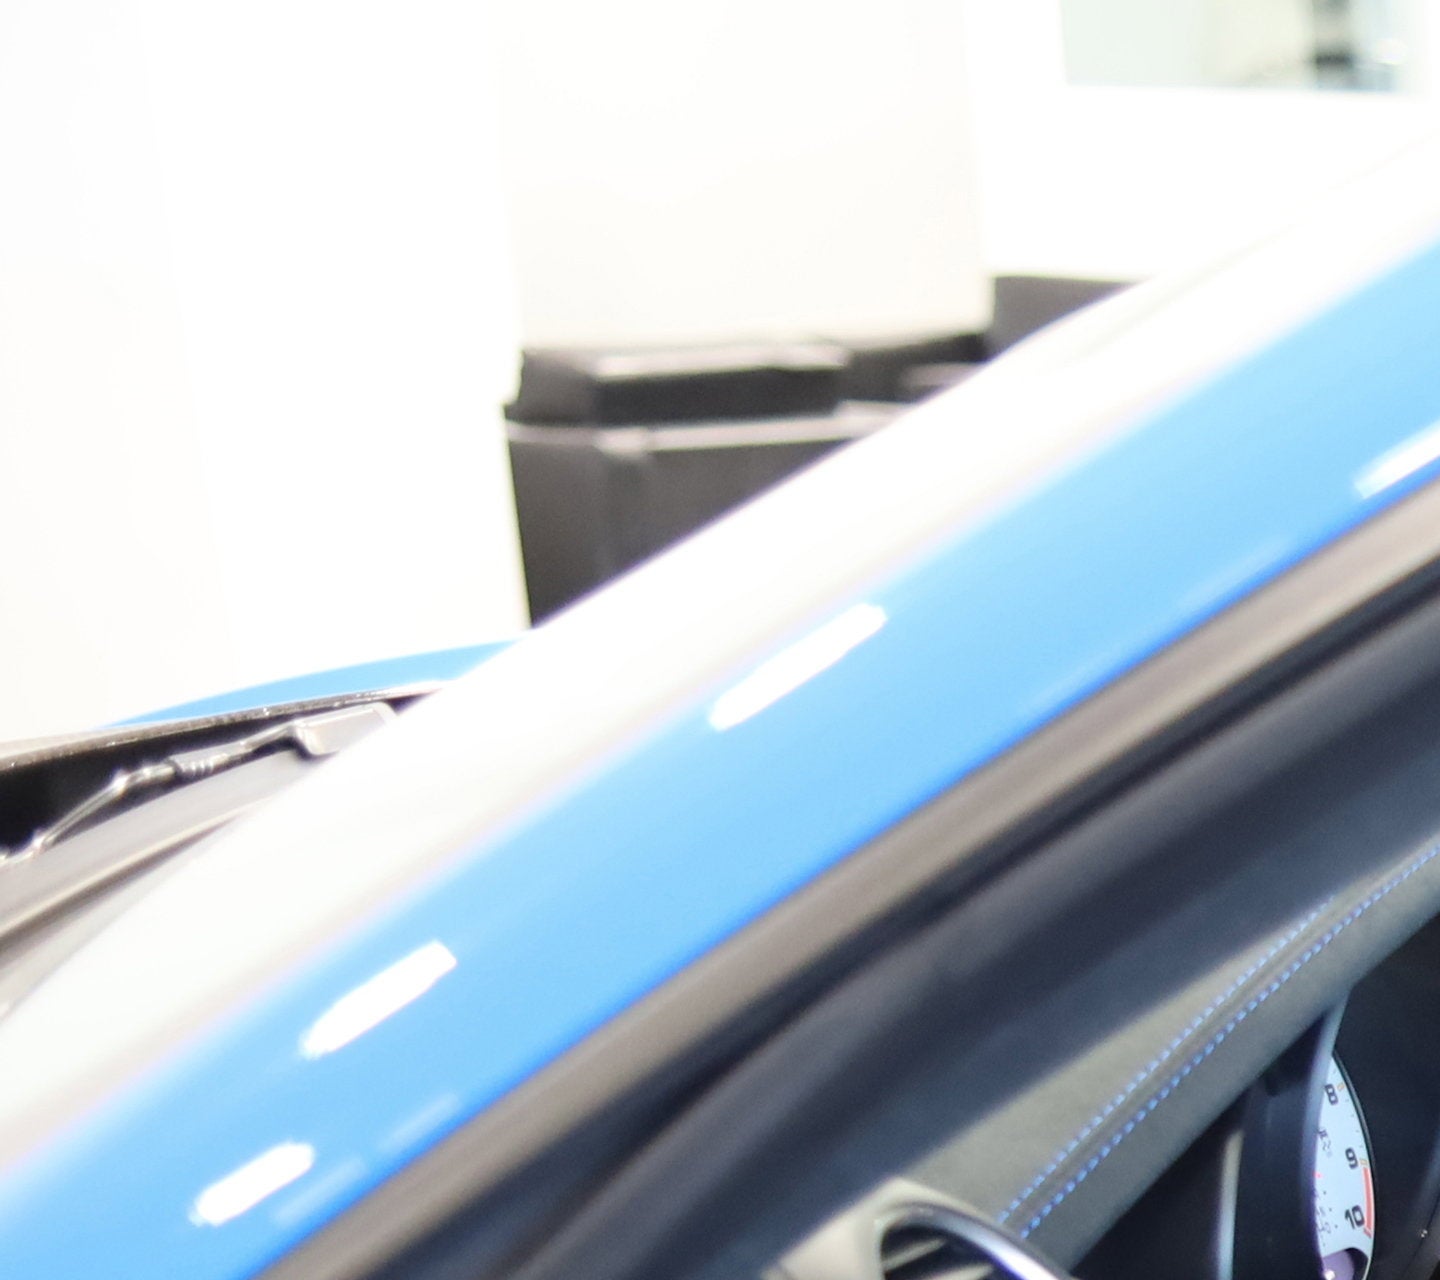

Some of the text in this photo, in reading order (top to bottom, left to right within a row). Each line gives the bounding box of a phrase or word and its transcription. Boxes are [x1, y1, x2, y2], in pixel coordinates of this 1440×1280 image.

[1325, 1084, 1338, 1105] 8
[1344, 1147, 1359, 1170] 9
[1344, 1204, 1365, 1230] 10
